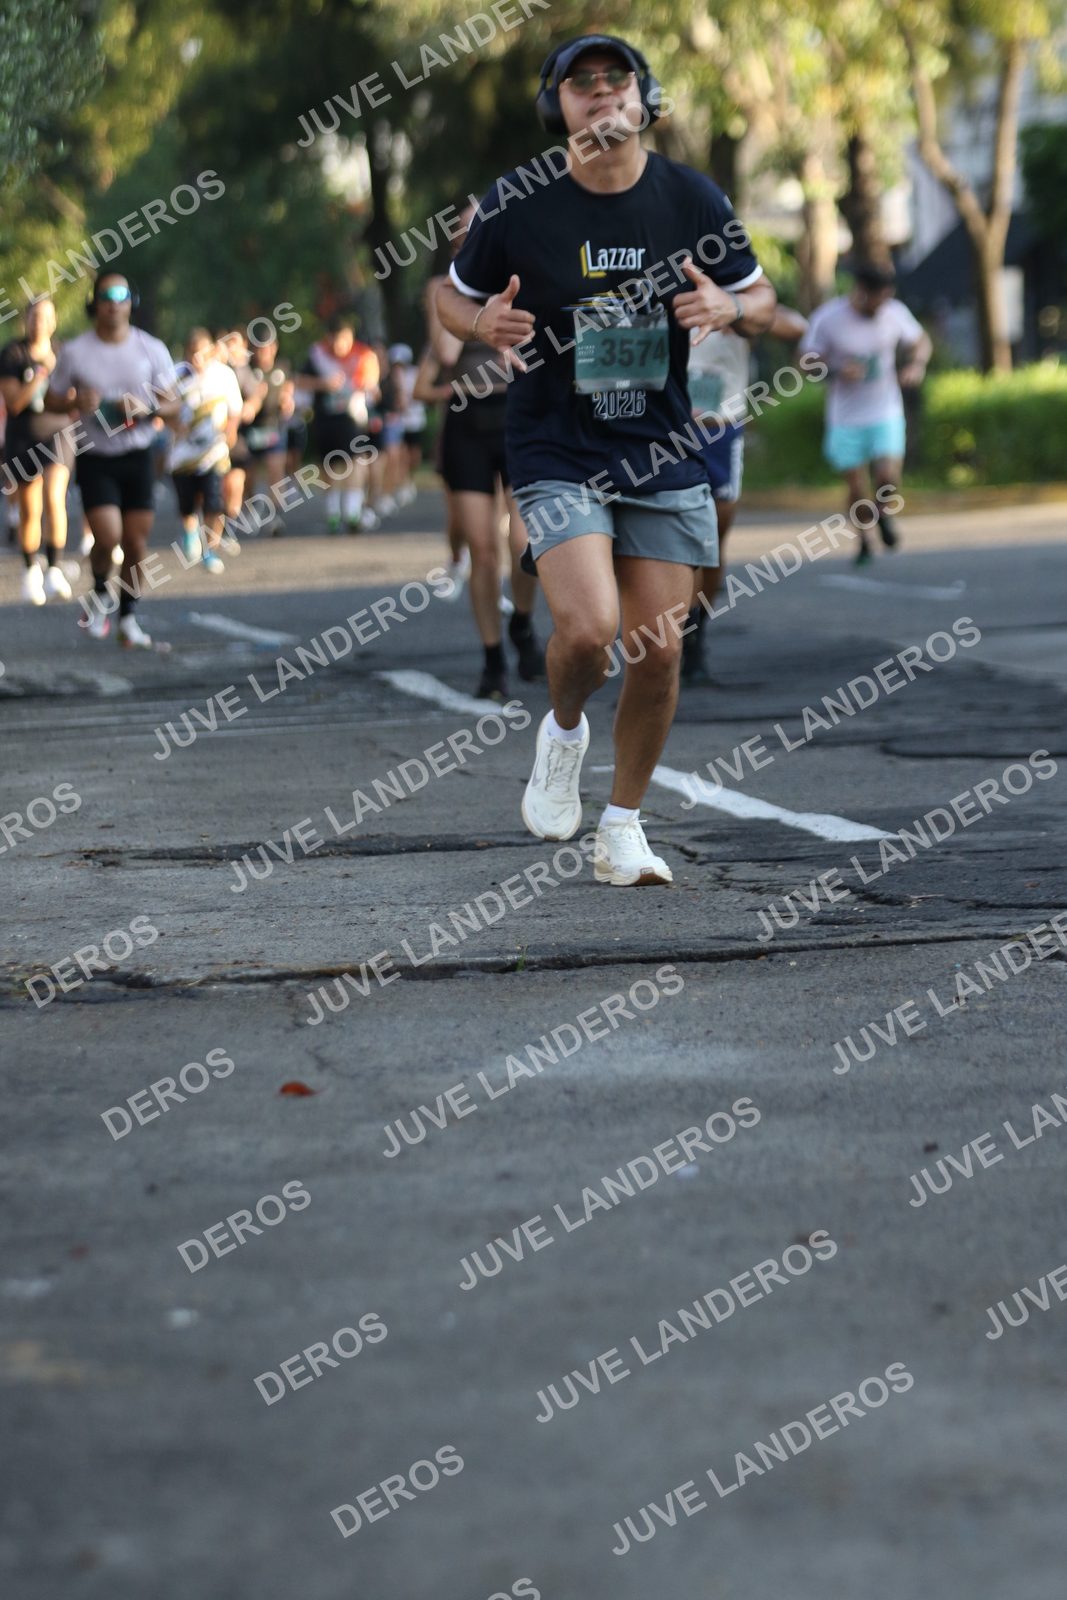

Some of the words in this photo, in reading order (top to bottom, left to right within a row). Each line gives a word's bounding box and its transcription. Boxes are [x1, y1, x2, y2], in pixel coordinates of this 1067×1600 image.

[581, 240, 646, 277] Lazzar
[601, 336, 668, 368] 3574
[592, 389, 647, 419] 2026
